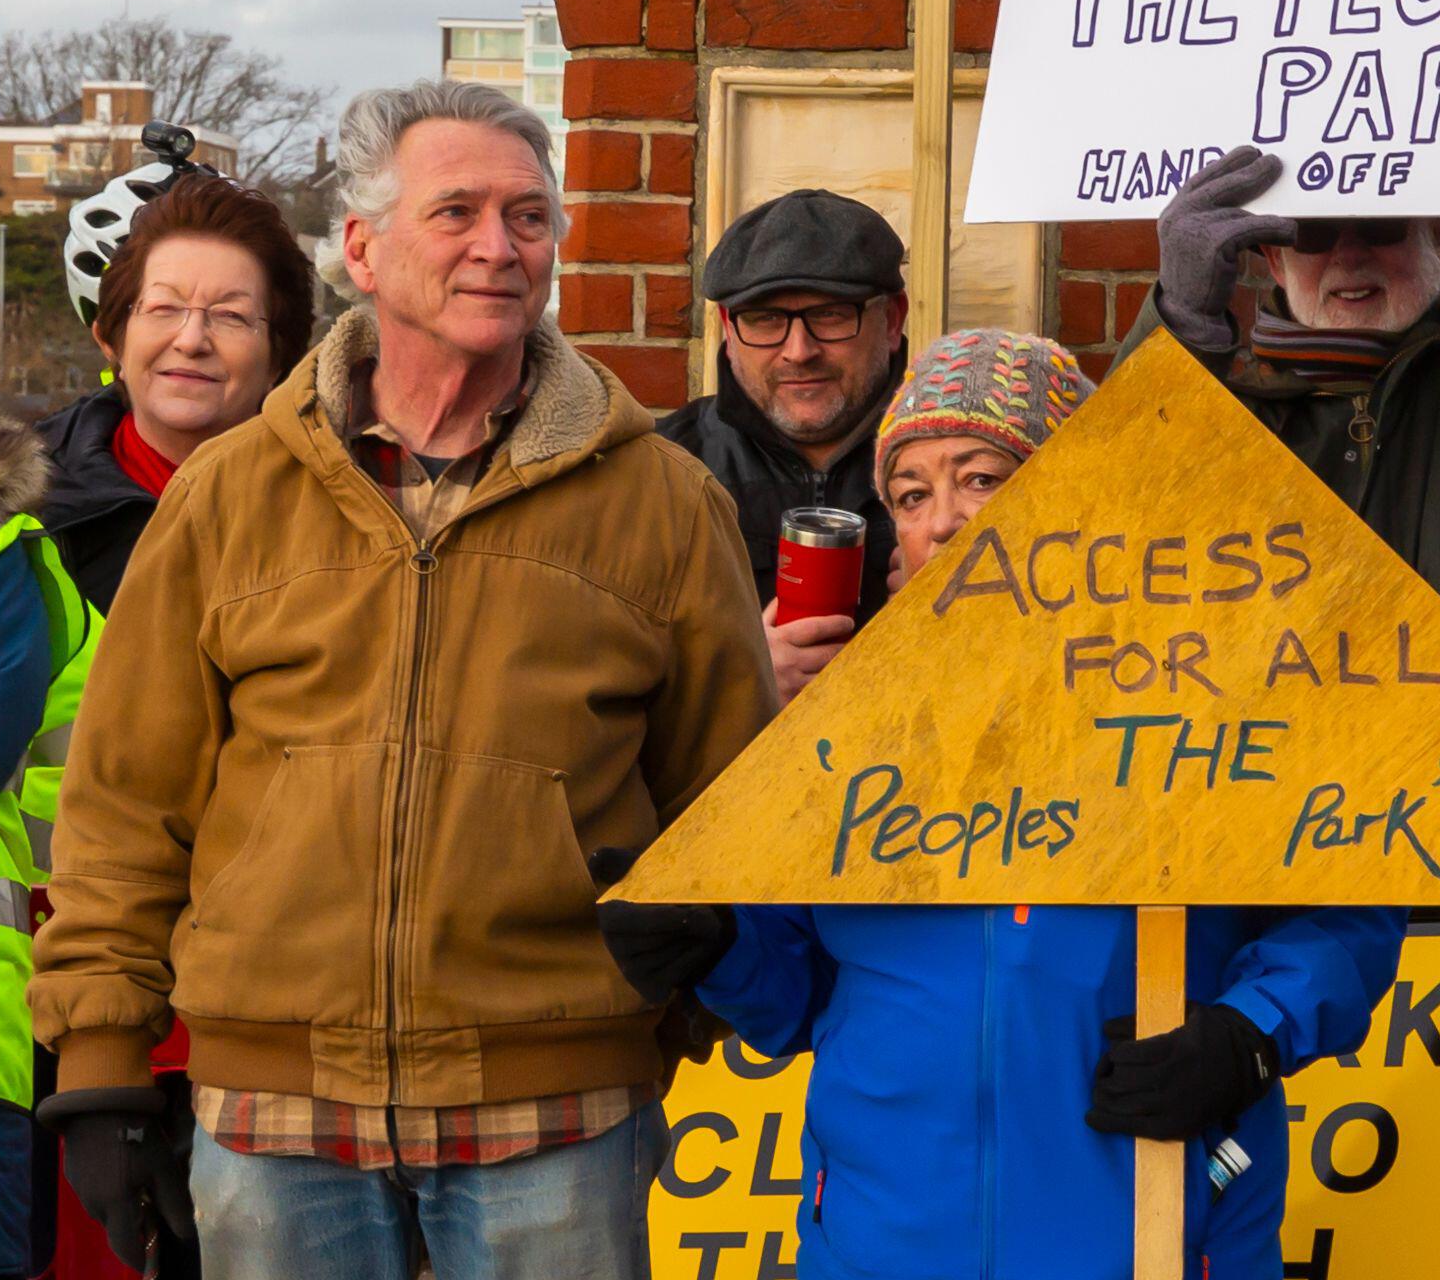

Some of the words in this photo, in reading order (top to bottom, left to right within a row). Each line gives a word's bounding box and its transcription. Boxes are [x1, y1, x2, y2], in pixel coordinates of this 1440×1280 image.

[1077, 145, 1262, 204] HAN
[1296, 151, 1416, 196] OFF
[932, 521, 1313, 618] ACCESS
[1065, 630, 1223, 695] FOR
[1094, 713, 1288, 793] THE
